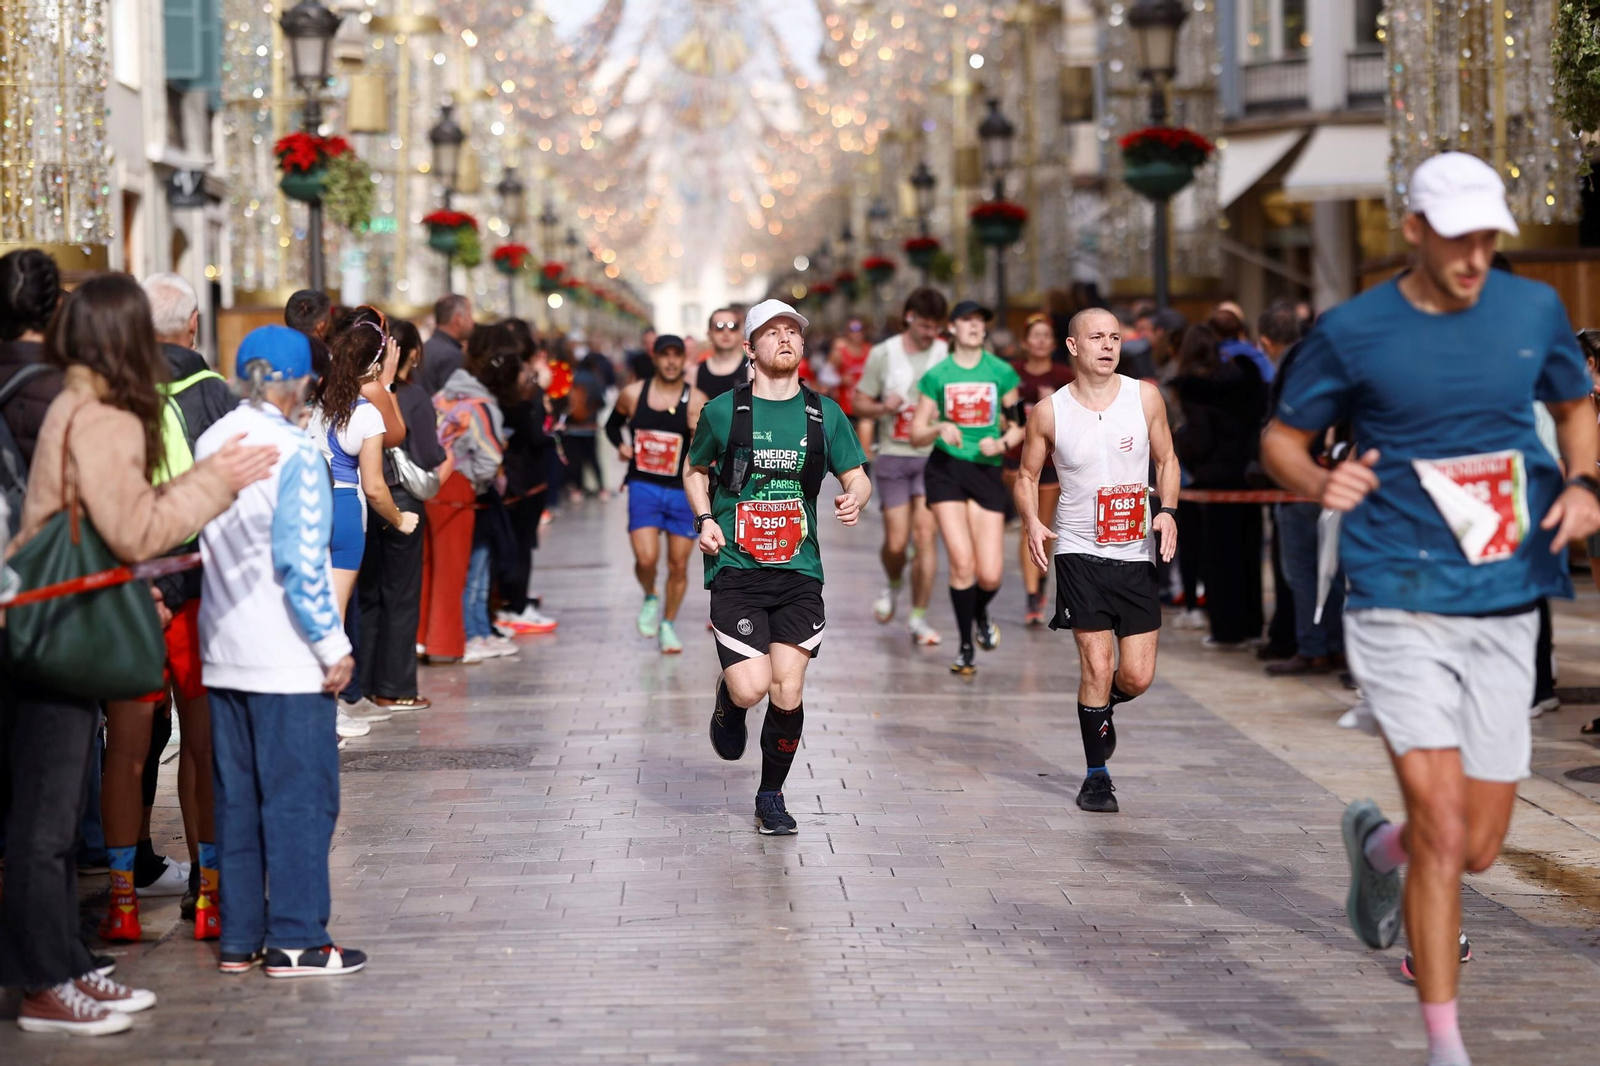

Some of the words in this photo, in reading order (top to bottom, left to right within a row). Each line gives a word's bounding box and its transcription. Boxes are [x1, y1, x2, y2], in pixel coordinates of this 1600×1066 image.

[753, 449, 798, 460] CHNEIDER
[754, 460, 797, 470] ELECTRIC
[771, 480, 794, 489] PARIS
[755, 501, 798, 512] GENERALI
[753, 516, 786, 529] 9350
